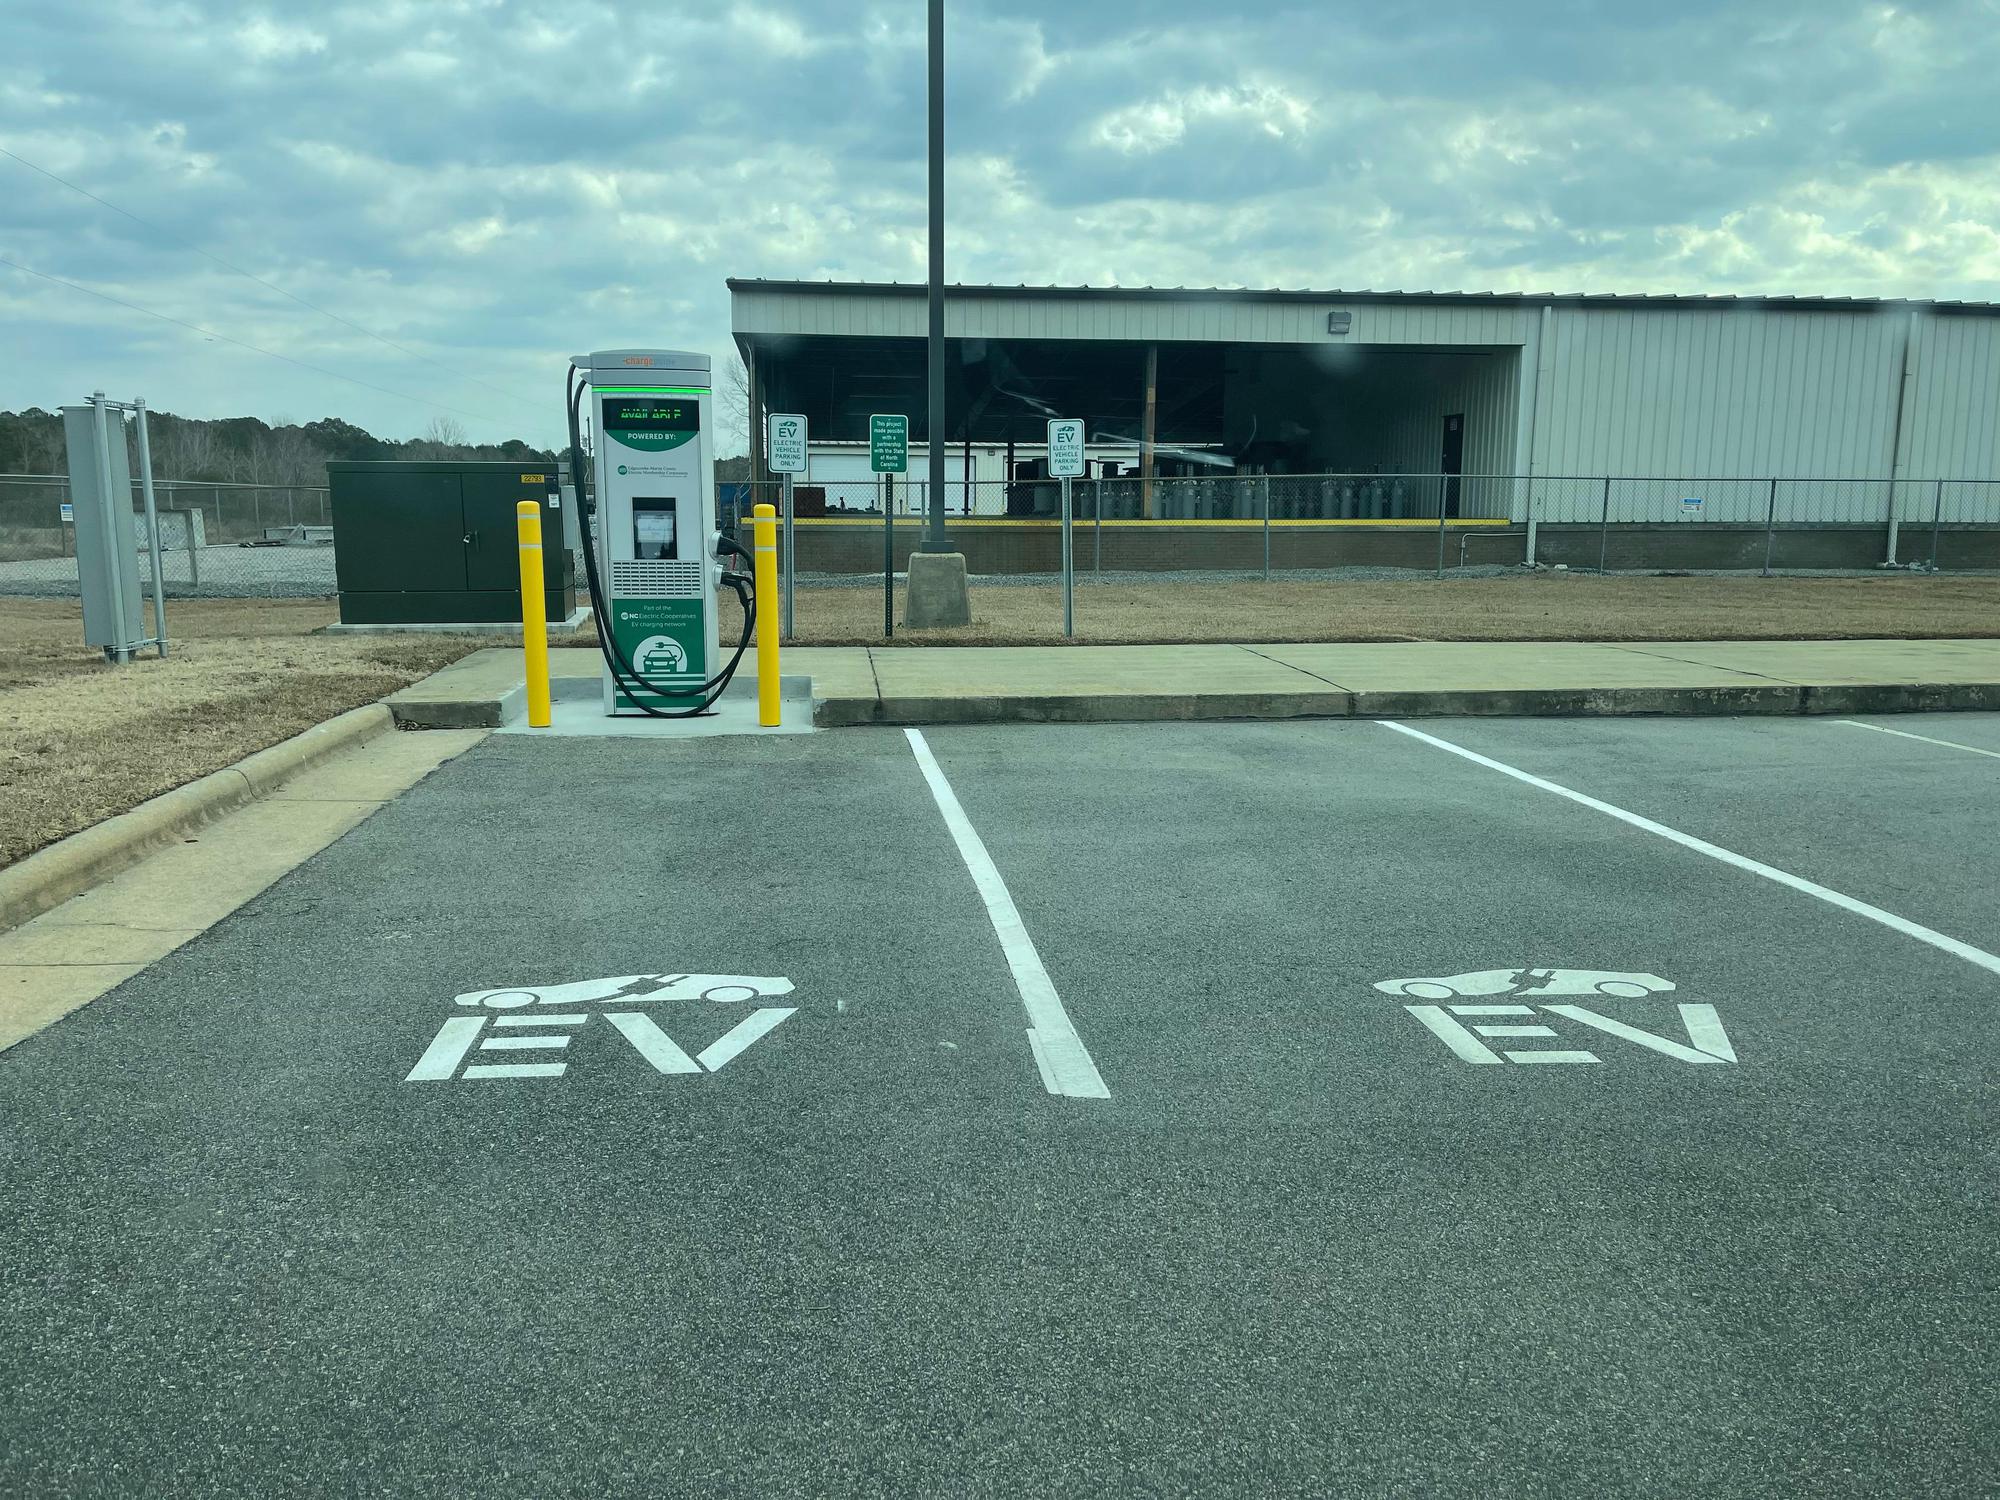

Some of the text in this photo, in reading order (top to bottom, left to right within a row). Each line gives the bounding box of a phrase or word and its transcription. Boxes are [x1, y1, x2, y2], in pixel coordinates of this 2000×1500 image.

[779, 428, 797, 438] EV
[1058, 433, 1074, 442] EV
[404, 1007, 800, 1081] EV
[1403, 1003, 1738, 1064] EV
